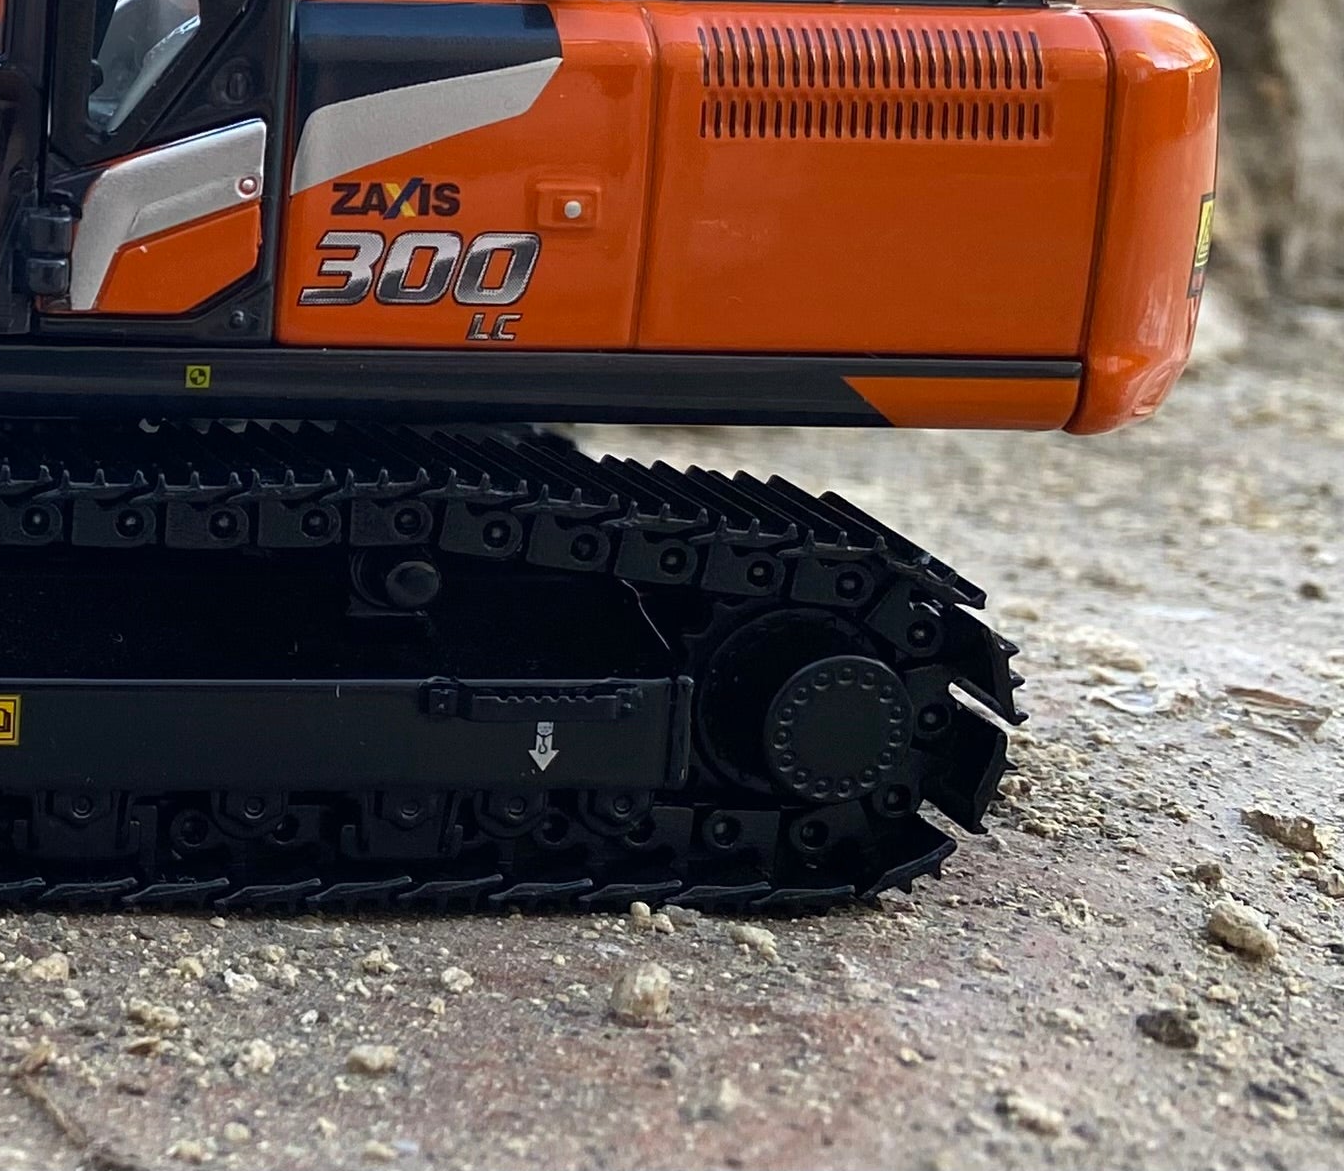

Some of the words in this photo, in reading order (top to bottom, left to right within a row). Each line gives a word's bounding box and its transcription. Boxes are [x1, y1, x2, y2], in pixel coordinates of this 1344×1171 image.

[330, 178, 461, 220] ZAXIS
[298, 230, 541, 306] 300
[466, 313, 522, 340] LC
